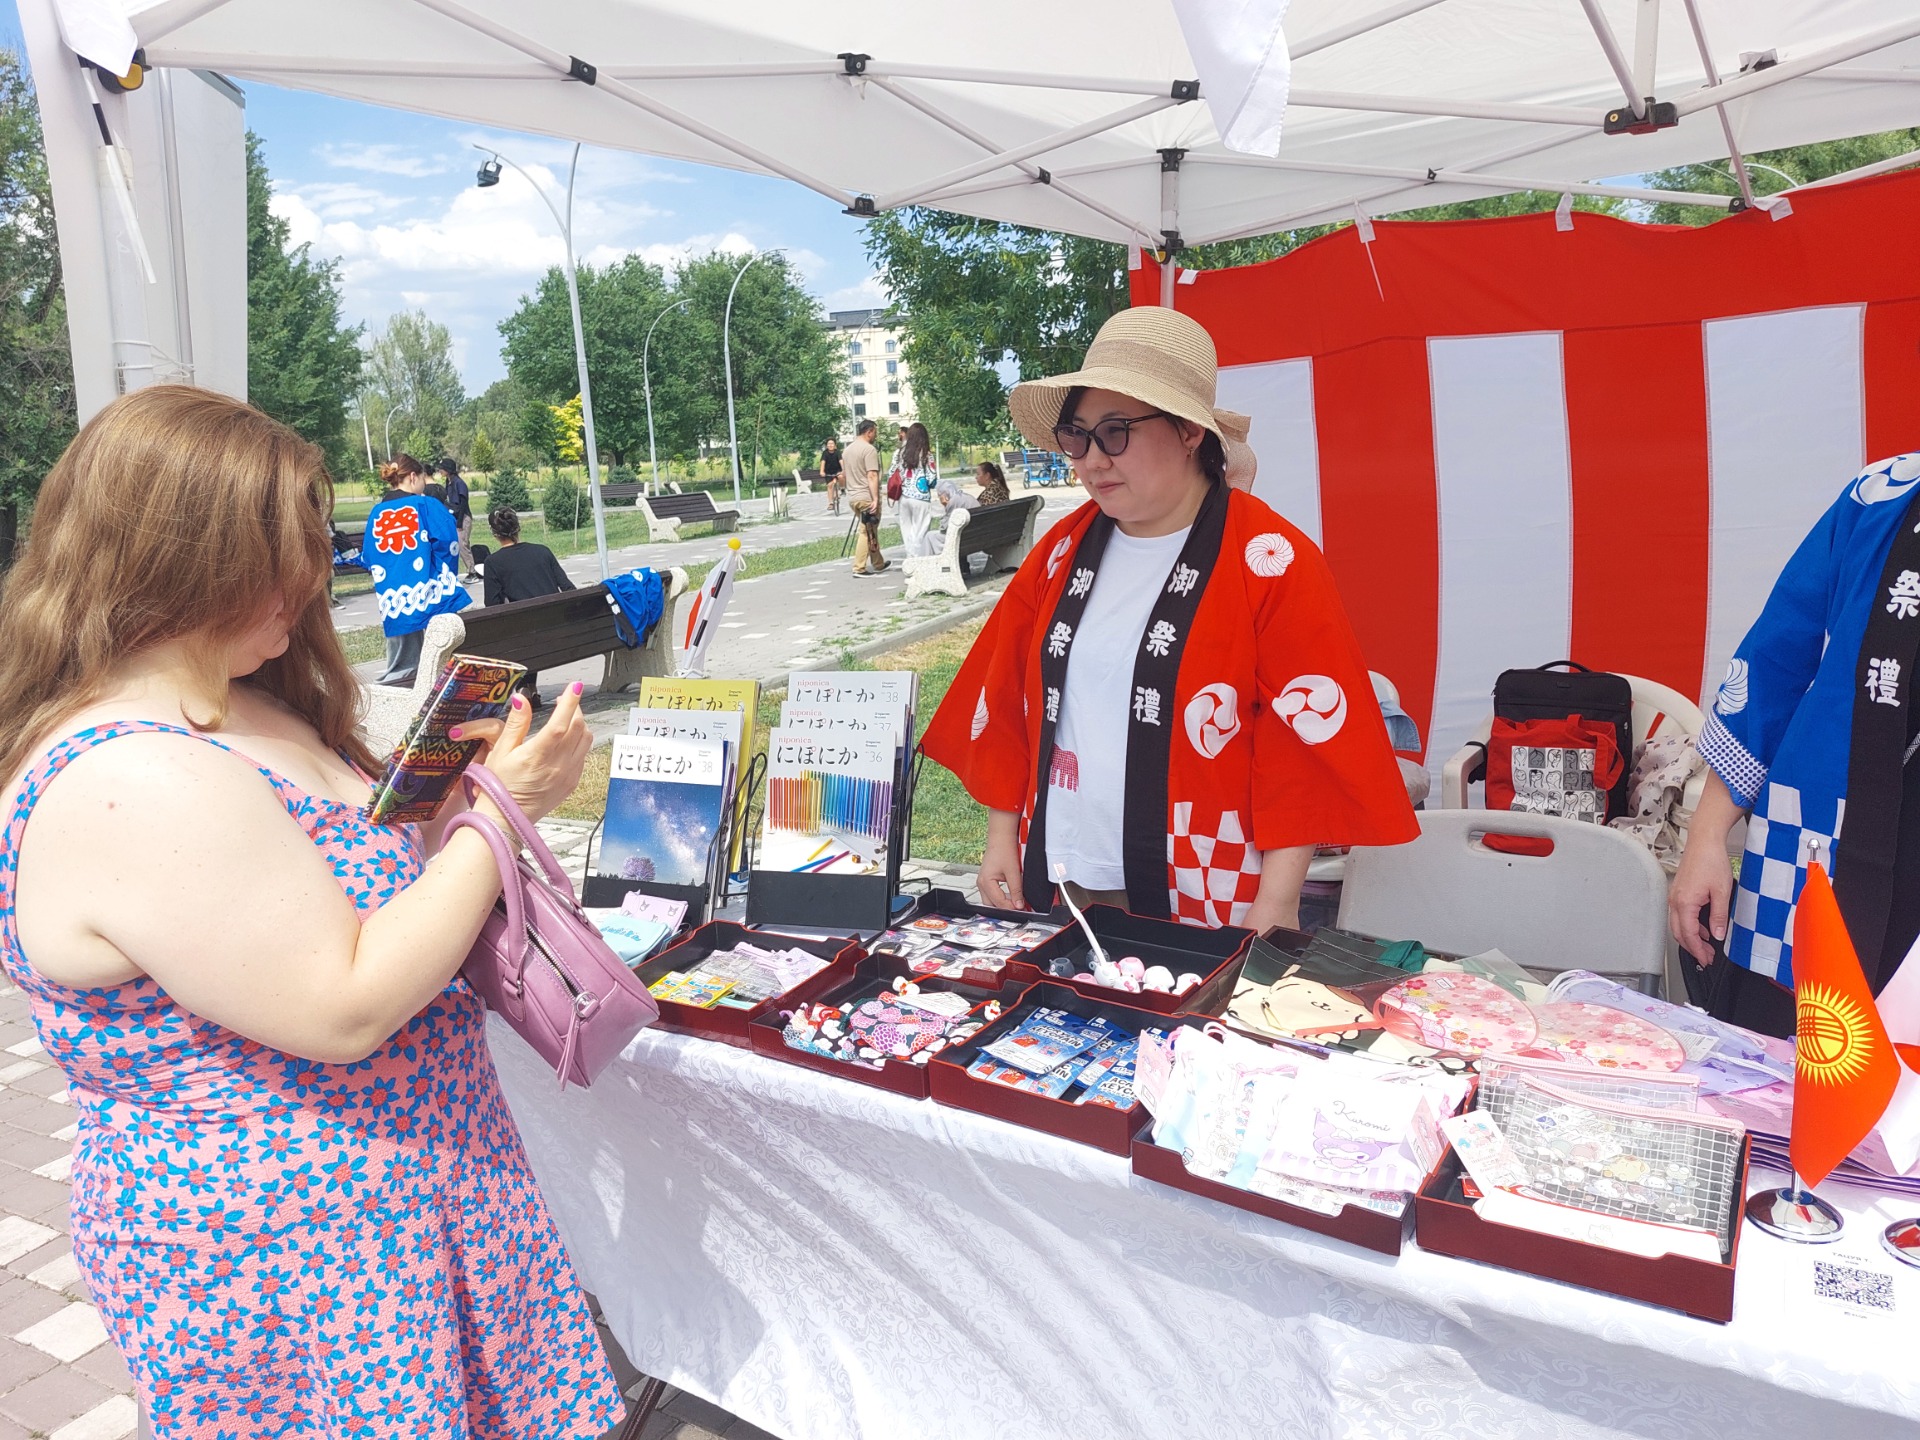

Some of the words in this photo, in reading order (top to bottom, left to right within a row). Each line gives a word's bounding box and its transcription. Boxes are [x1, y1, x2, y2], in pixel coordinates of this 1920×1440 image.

[372, 505, 420, 555] 祭
[797, 679, 830, 687] niponica
[649, 685, 682, 693] niponica
[789, 709, 822, 717] niponica
[637, 717, 667, 725] niponica
[778, 736, 812, 744] niponica
[776, 745, 858, 766] にぽにか
[869, 751, 883, 763] 36
[618, 752, 692, 775] にぽにか
[1333, 1100, 1391, 1131] Kuromi
